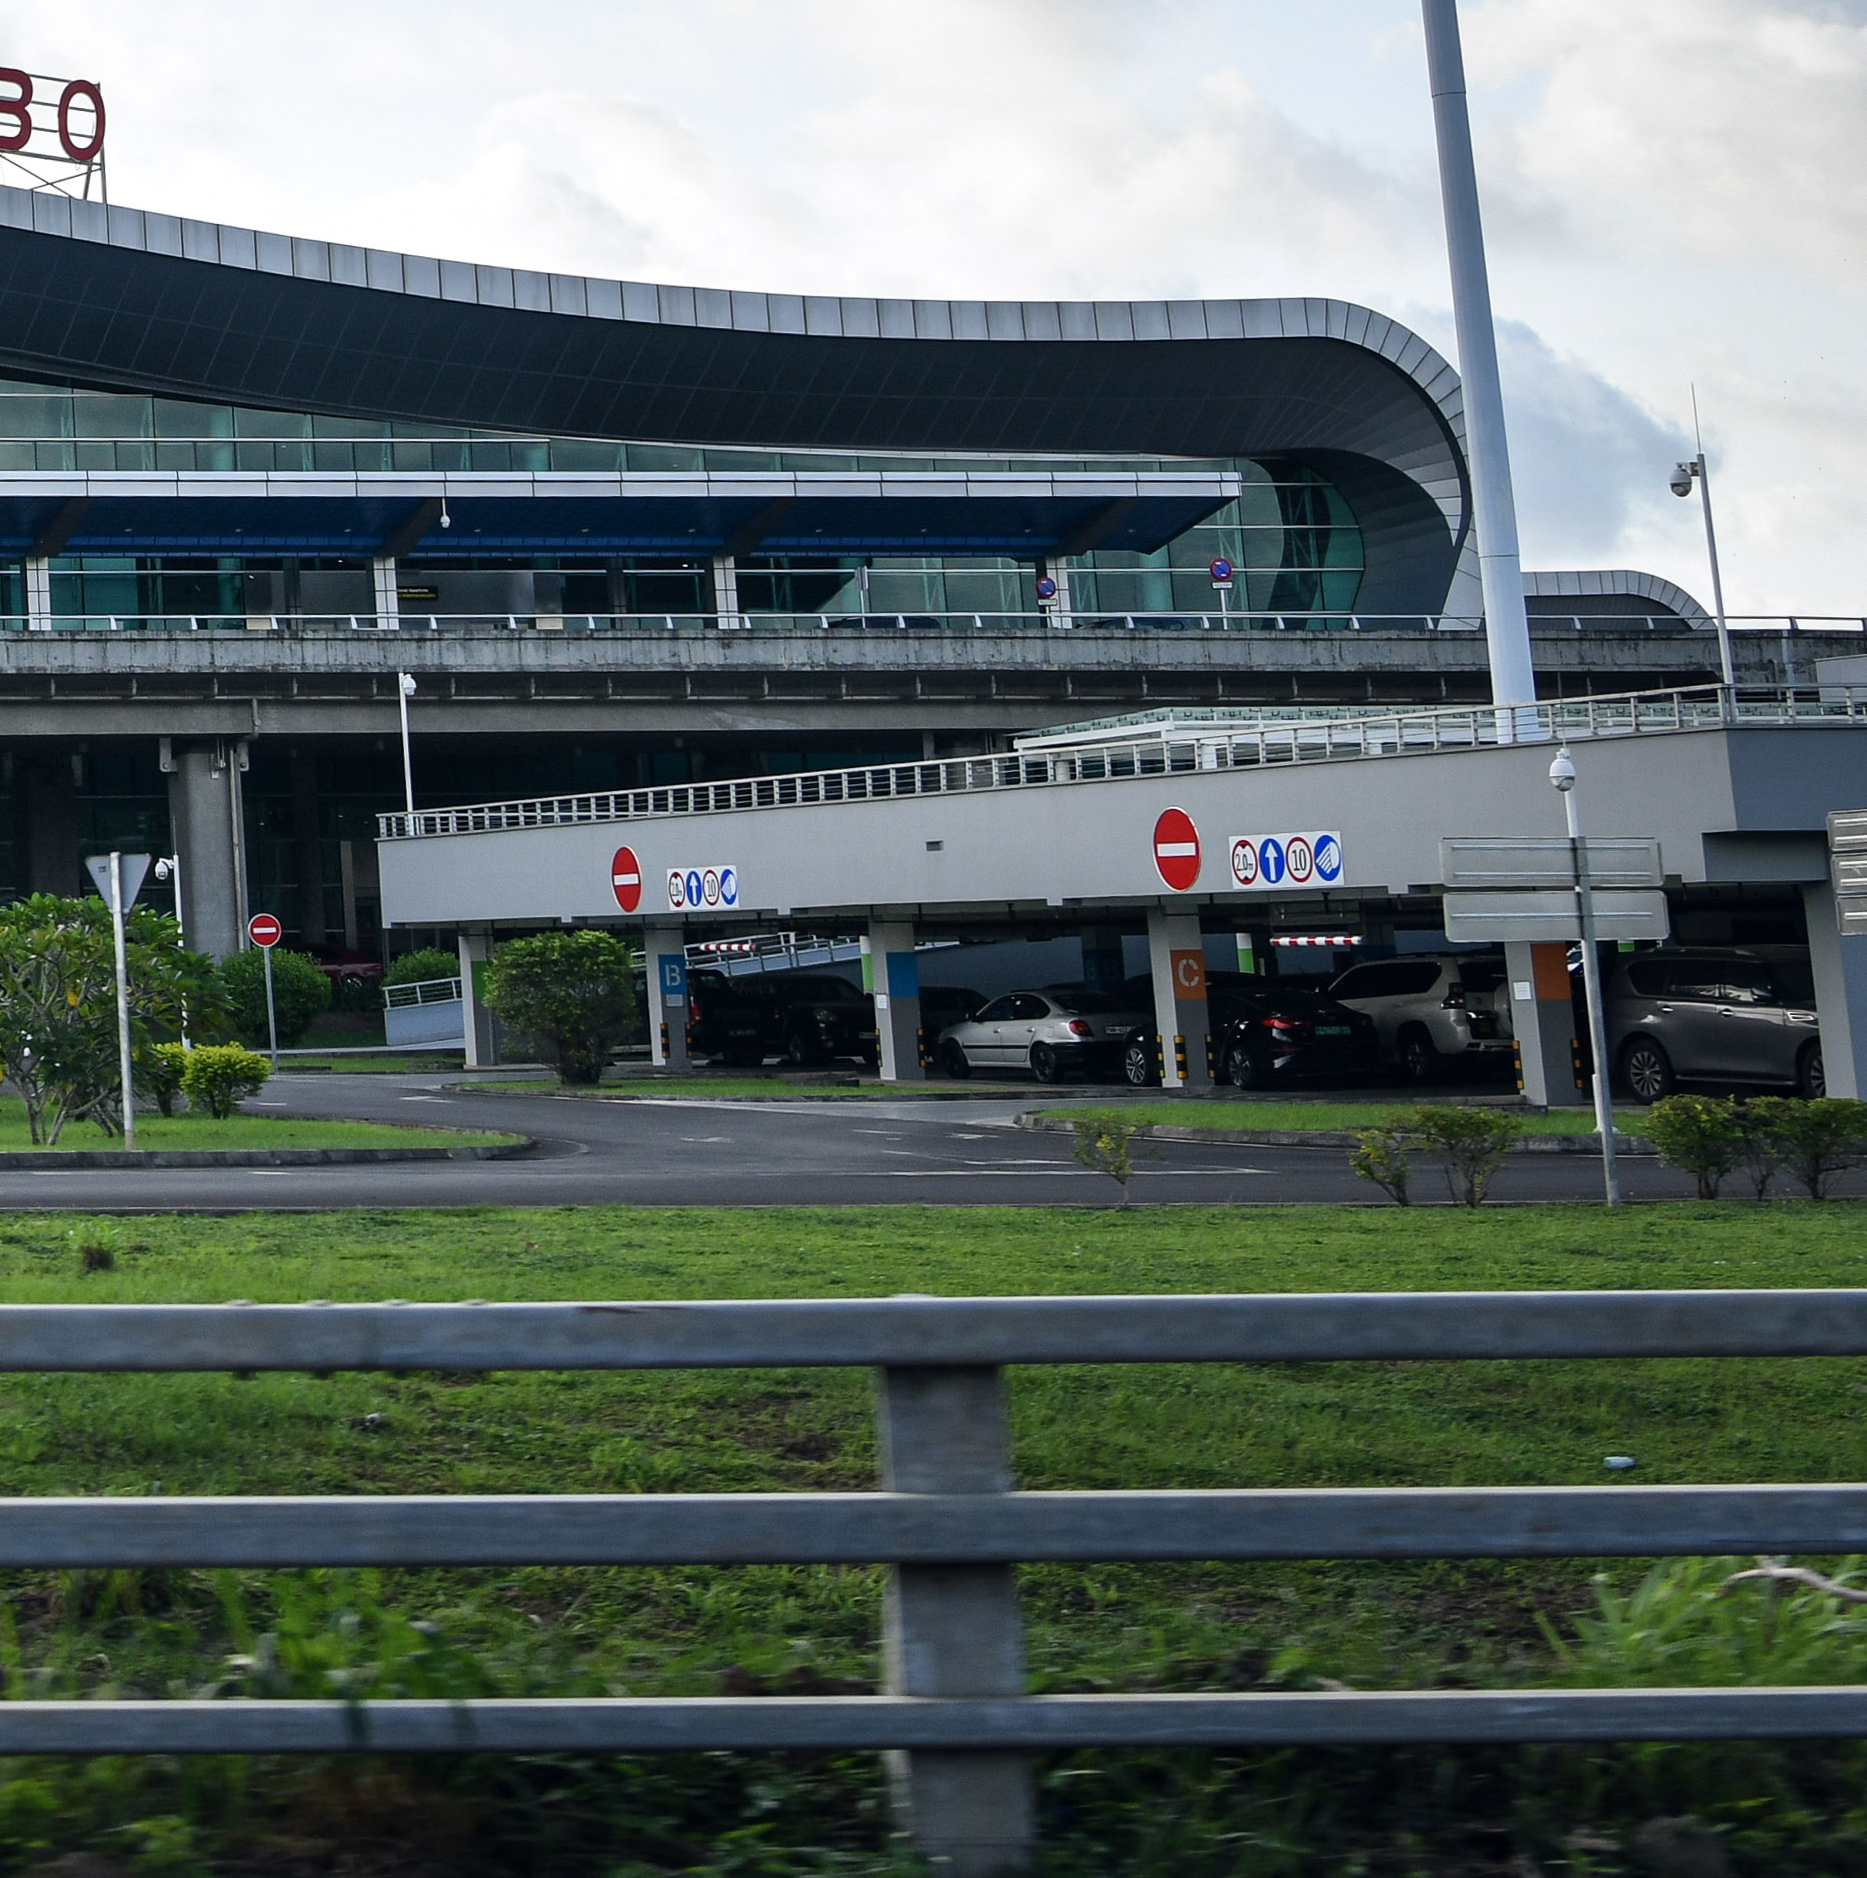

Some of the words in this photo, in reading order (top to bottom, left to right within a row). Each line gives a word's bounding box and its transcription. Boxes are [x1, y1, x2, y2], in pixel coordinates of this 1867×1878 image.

[1291, 848, 1307, 872] 10
[705, 879, 717, 898] 10
[665, 964, 681, 987] B
[1177, 958, 1200, 987] C
